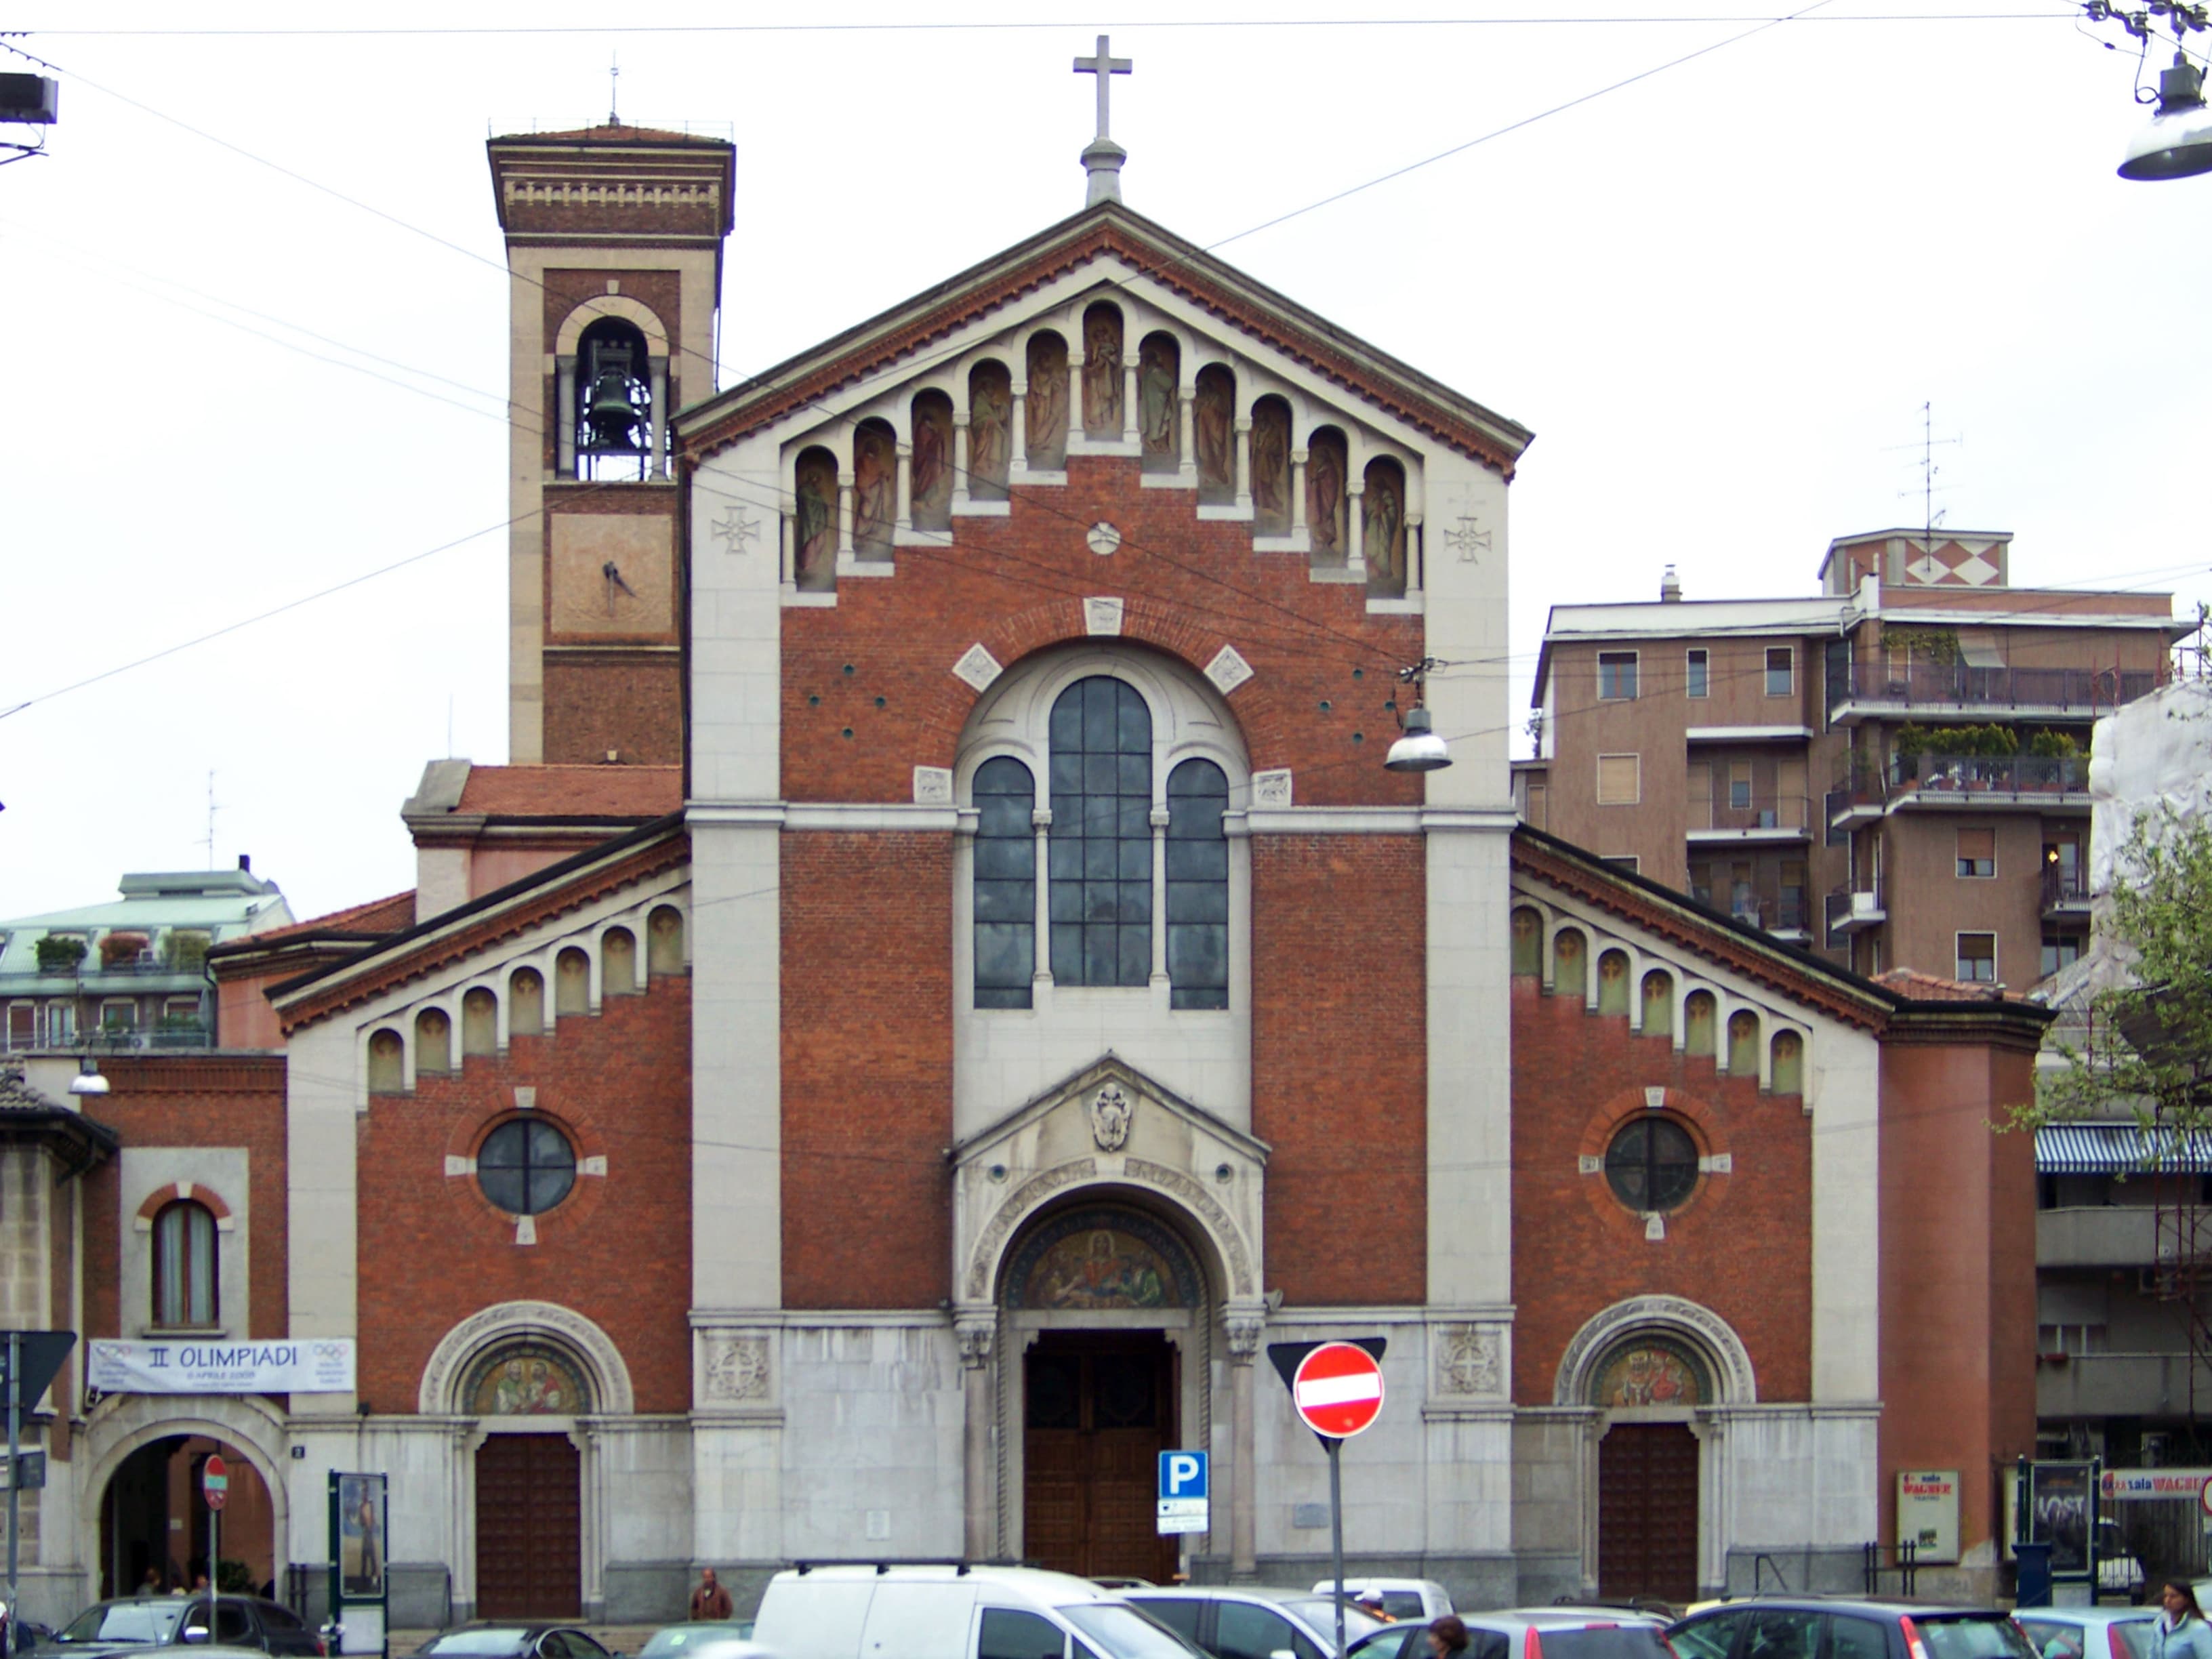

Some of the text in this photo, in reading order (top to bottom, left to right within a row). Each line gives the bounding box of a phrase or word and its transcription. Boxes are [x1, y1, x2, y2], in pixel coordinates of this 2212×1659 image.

[149, 1347, 297, 1368] II OLIMPIADI
[1170, 1455, 1199, 1494] P
[2128, 1477, 2152, 1490] sala
[2038, 1495, 2085, 1523] LOST
